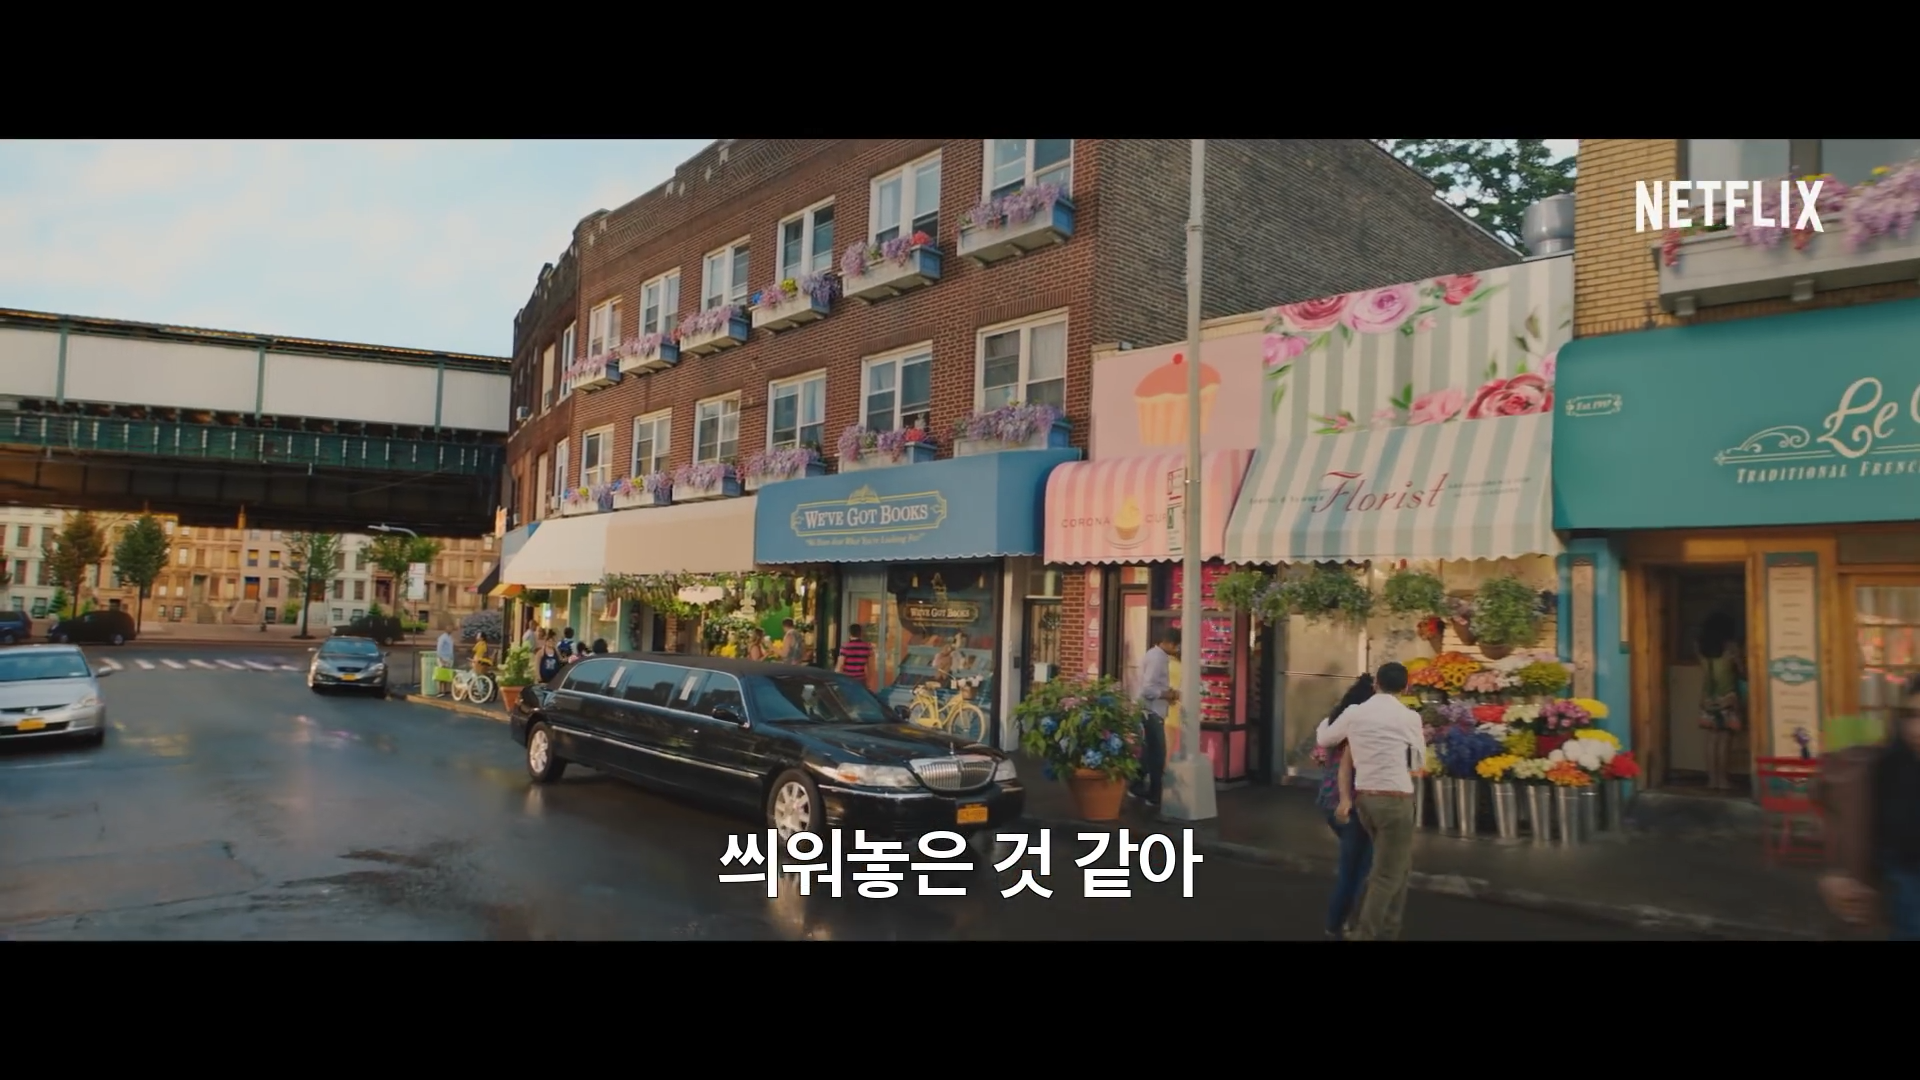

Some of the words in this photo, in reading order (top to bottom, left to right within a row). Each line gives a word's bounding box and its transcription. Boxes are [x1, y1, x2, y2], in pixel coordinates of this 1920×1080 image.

[1816, 377, 1899, 458] Le
[1737, 463, 1848, 484] TRADITIONAL
[1311, 471, 1449, 513] Florist
[804, 510, 844, 529] WE'VE
[847, 507, 878, 527] GOT
[880, 504, 928, 525] BOOKS
[1061, 517, 1111, 528] CORONA
